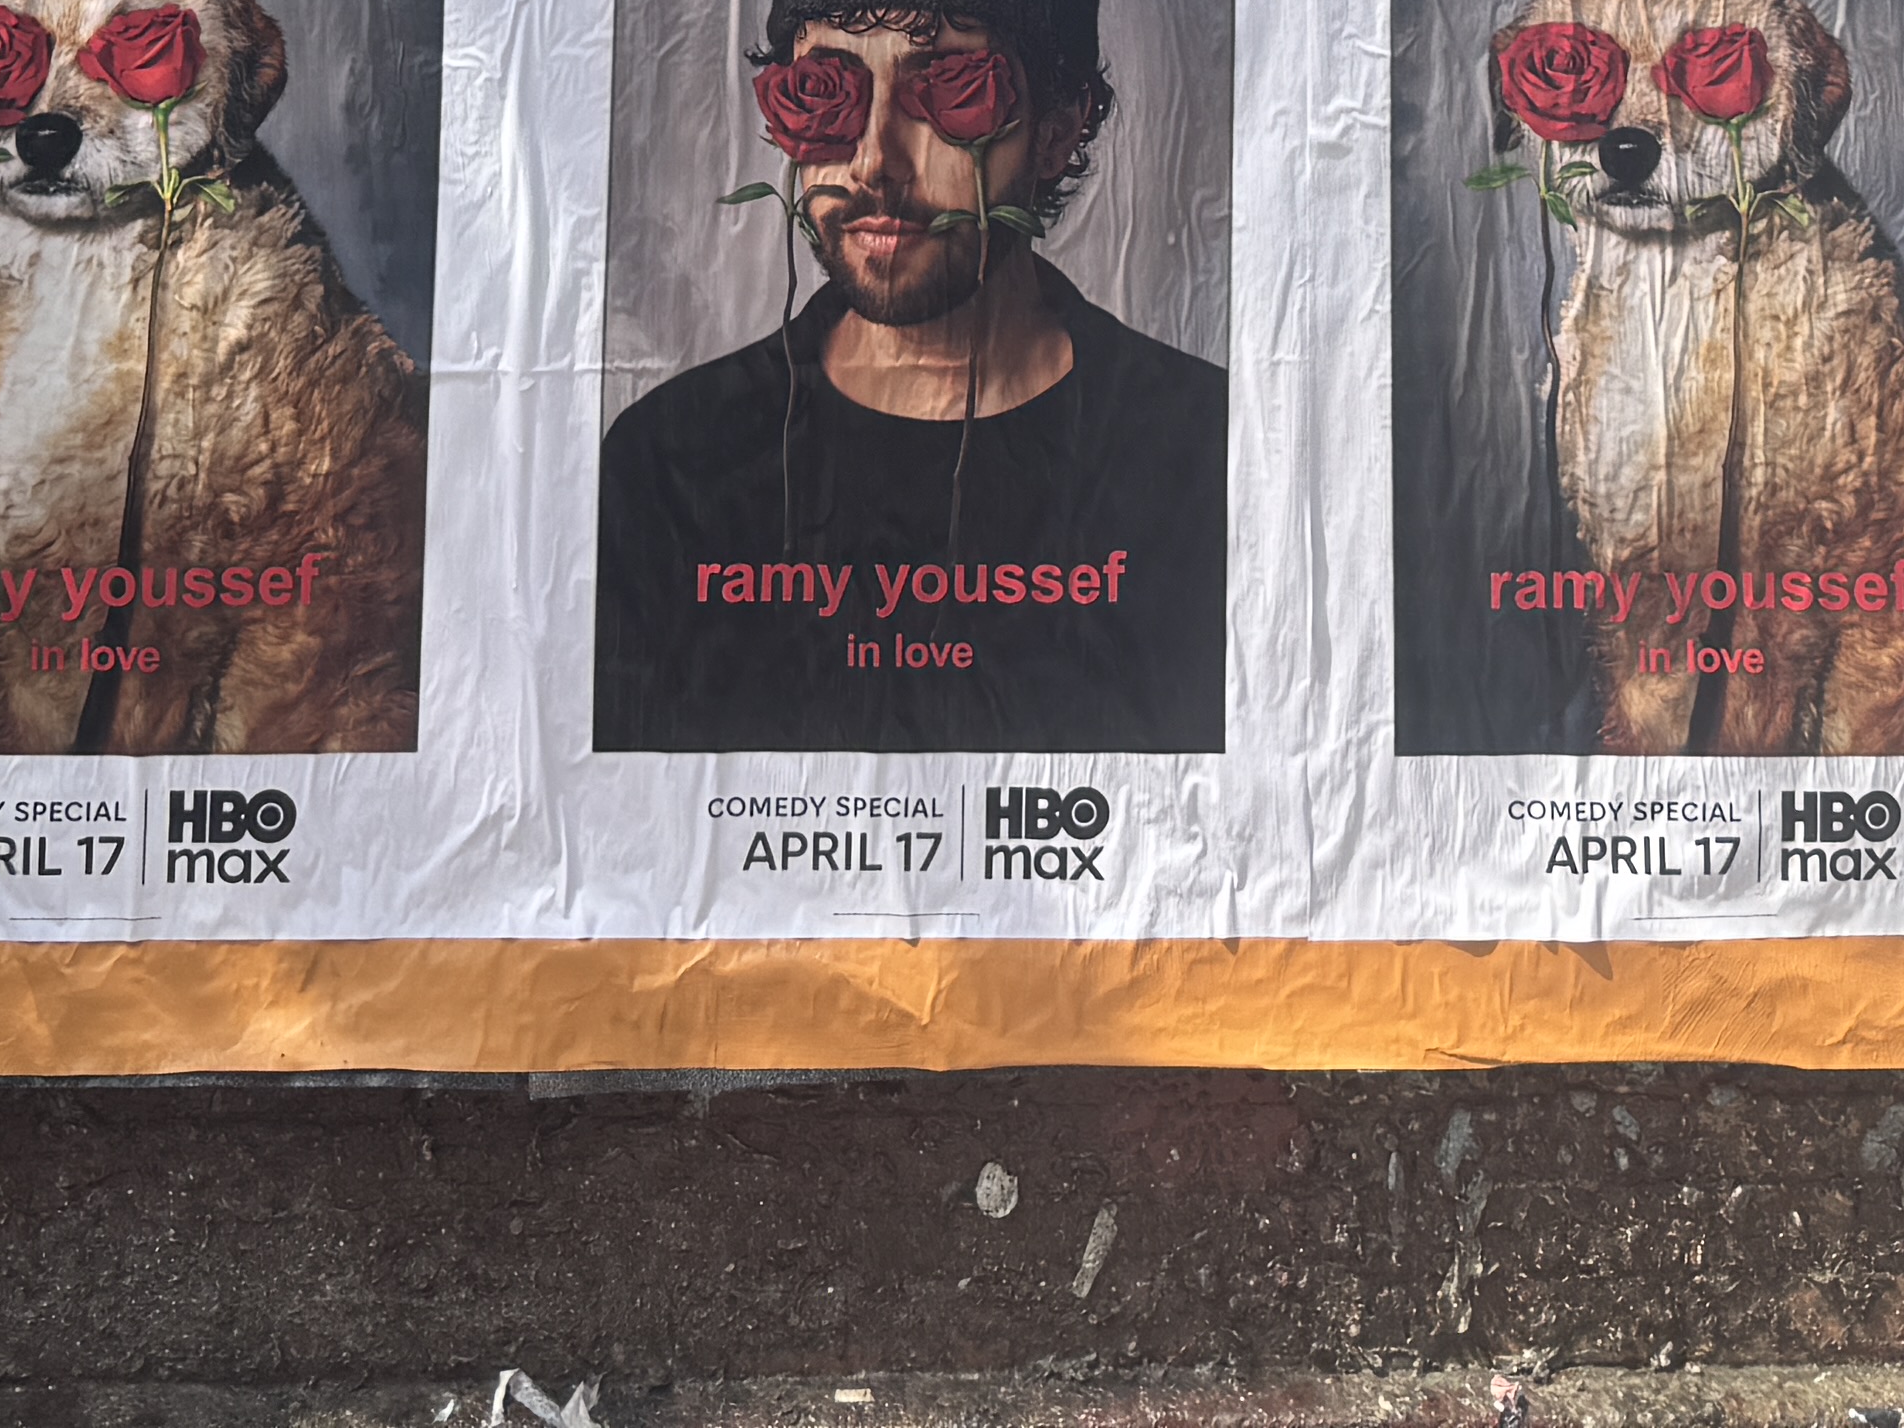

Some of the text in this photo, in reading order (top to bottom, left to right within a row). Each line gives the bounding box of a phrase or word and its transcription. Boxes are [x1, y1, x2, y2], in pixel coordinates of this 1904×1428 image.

[61, 553, 329, 621] youssef
[696, 550, 1128, 618] ramy youssef
[1490, 571, 1639, 622] ramy
[30, 638, 161, 673] in love
[847, 633, 974, 668] in love
[1638, 639, 1764, 674] in love
[14, 801, 127, 822] SPECIAL
[168, 789, 296, 843] HBO
[708, 797, 944, 818] COMEDY SPECIAL
[985, 786, 1109, 840] HBO
[1507, 801, 1741, 823] COMEDY SPECIAL
[1781, 790, 1901, 842] HBO
[77, 836, 126, 876] 17
[166, 849, 291, 884] max
[742, 831, 943, 872] APRIL 17
[985, 845, 1104, 881] max
[1545, 835, 1740, 875] APRIL 17
[1781, 847, 1897, 881] max
